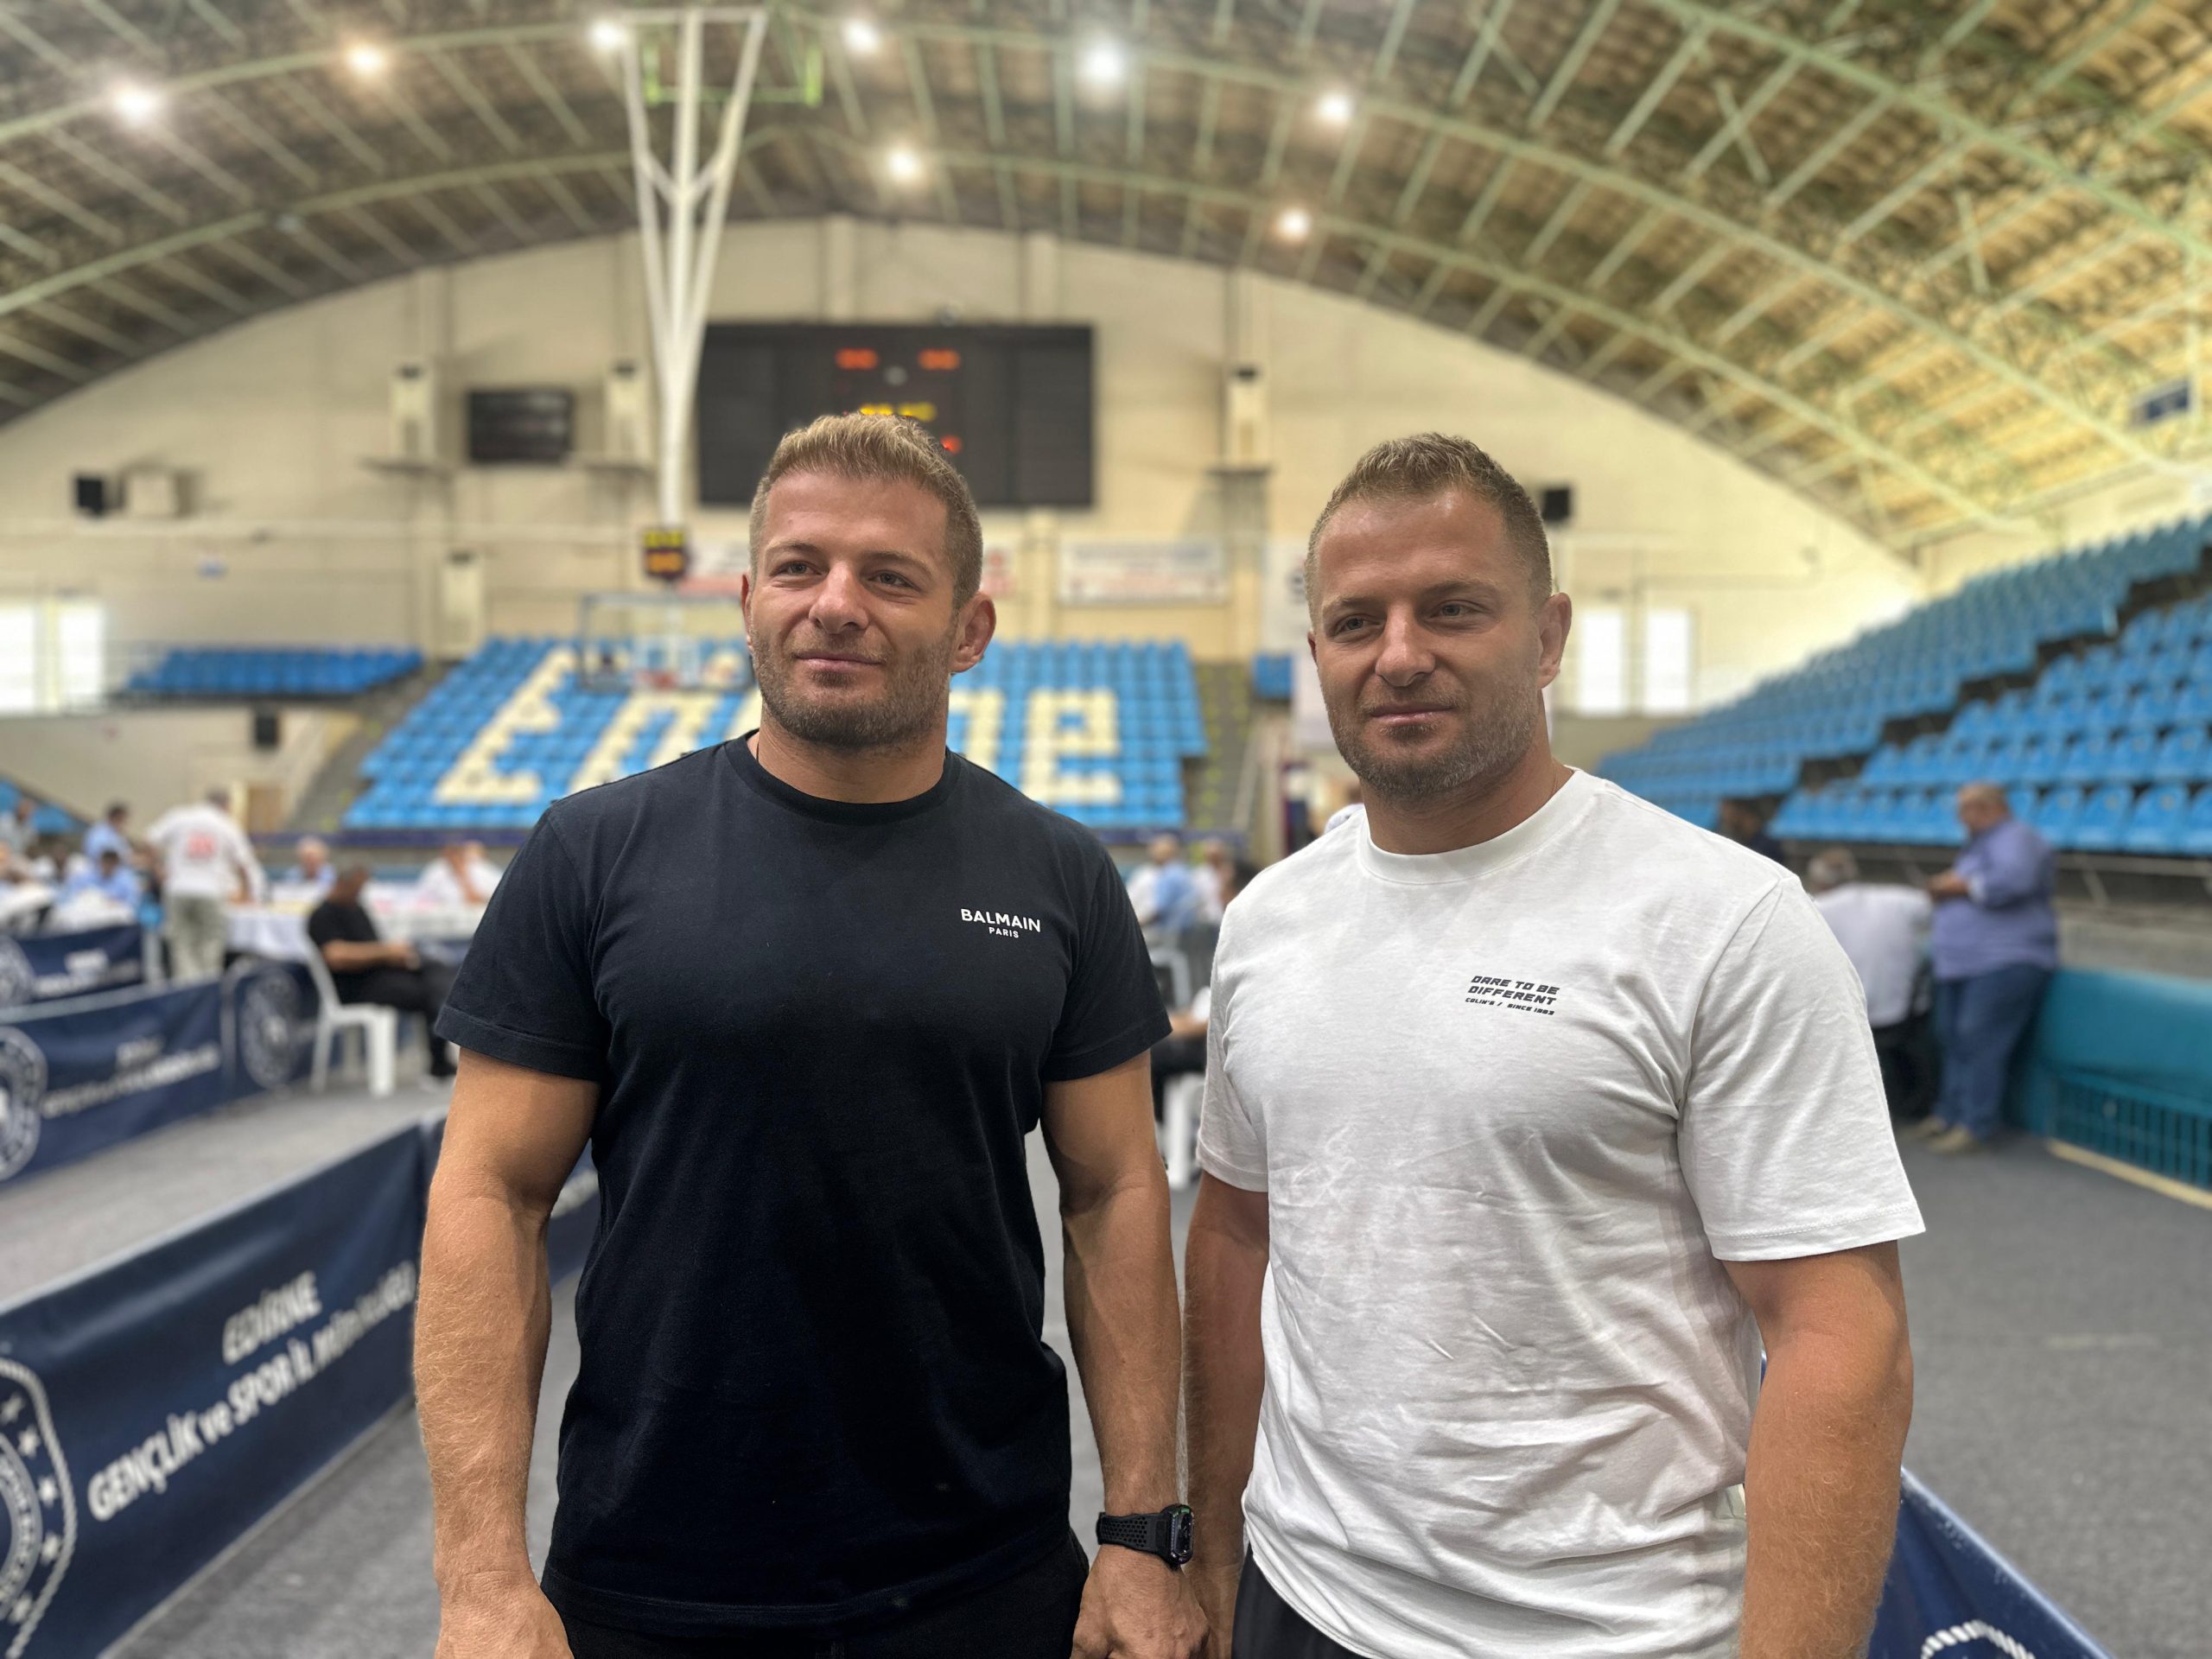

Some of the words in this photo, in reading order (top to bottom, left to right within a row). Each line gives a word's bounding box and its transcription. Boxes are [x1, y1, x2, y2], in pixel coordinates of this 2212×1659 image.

[961, 908, 1040, 932] BALMAIN
[988, 926, 1019, 938] PARIS
[1468, 985, 1556, 1005] DIFFERENT
[1471, 976, 1512, 987] DARE
[1515, 981, 1535, 991] TO
[1536, 984, 1560, 995] BE
[1506, 1003, 1533, 1012] SINCE
[87, 1411, 204, 1522] GENÇLİK
[198, 1401, 234, 1444] ve
[227, 1352, 297, 1426] SPOR
